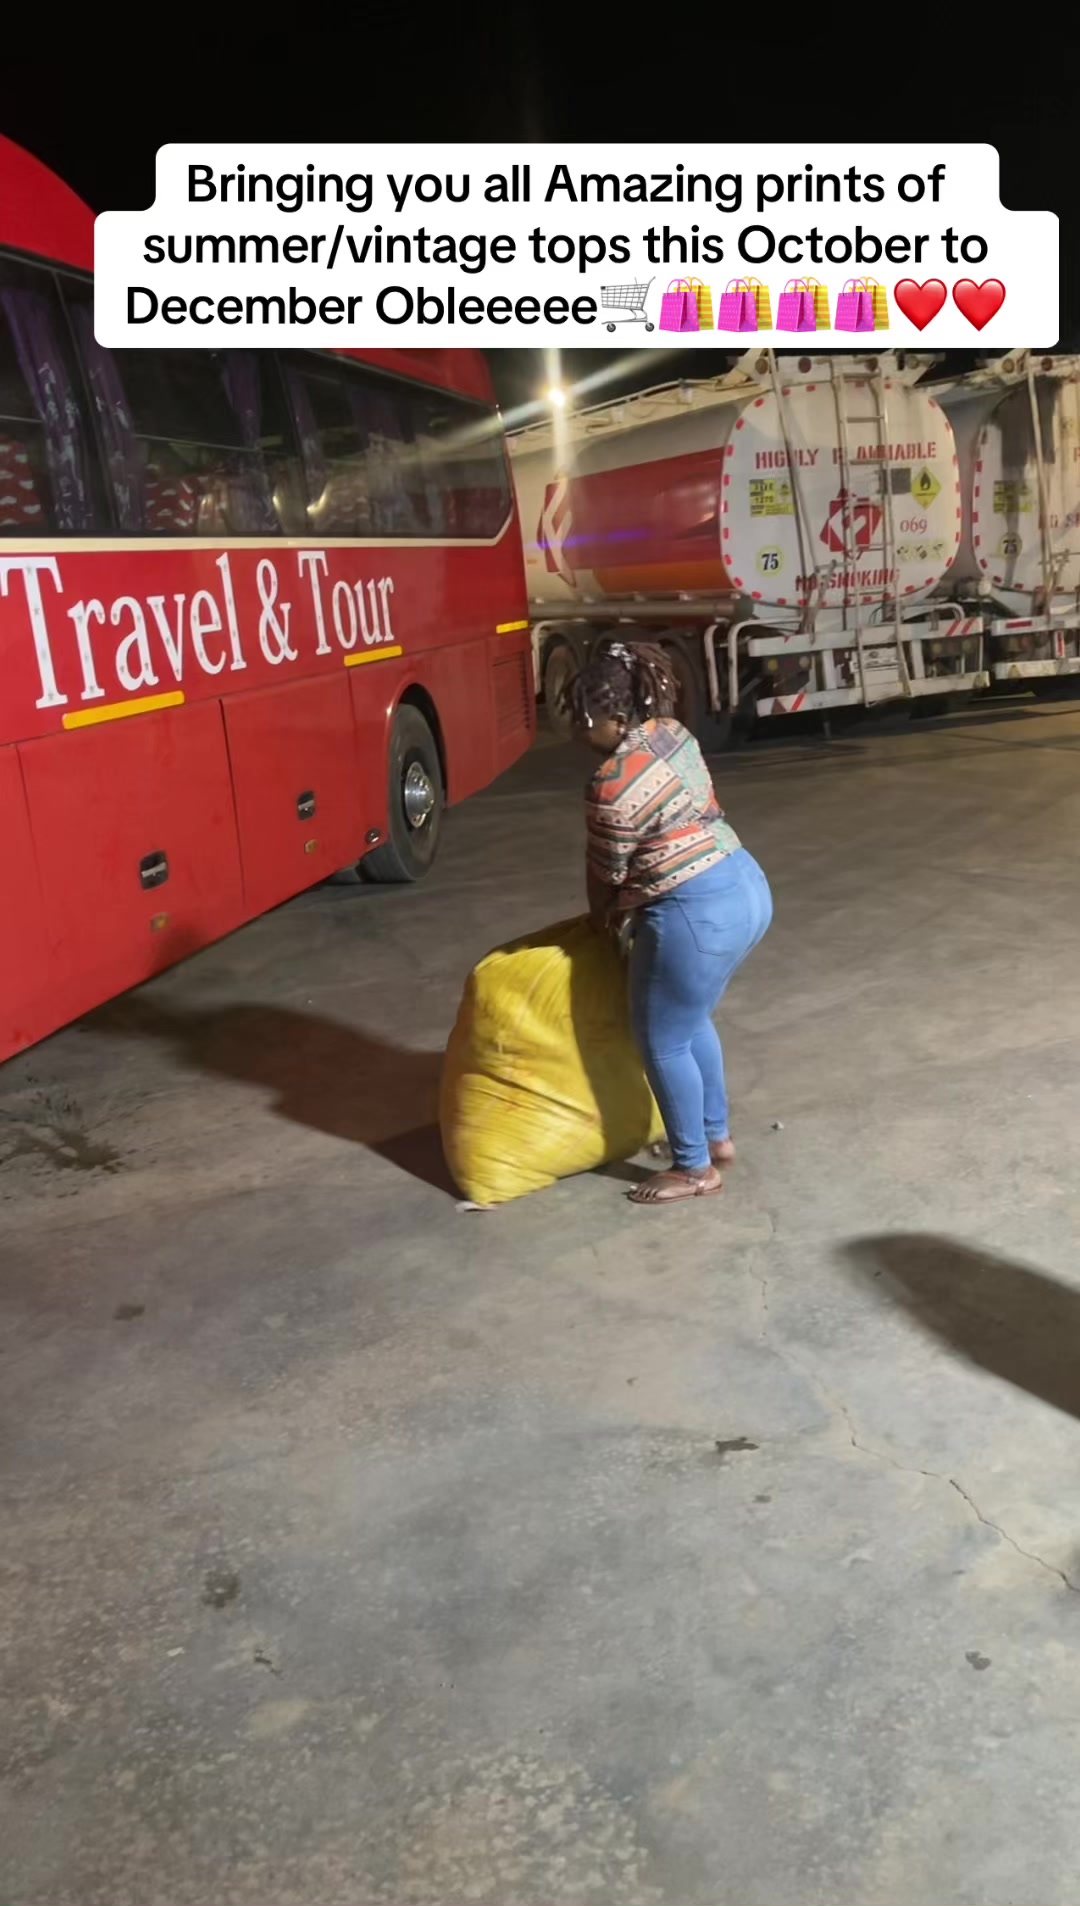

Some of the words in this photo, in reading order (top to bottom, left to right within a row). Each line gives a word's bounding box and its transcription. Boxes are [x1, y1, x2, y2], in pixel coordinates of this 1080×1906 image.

[832, 442, 937, 466] FAMMABLE
[900, 518, 927, 533] 069
[761, 553, 779, 570] 75
[0, 552, 247, 709] Travel
[255, 558, 298, 666] &
[298, 550, 396, 656] Tour
